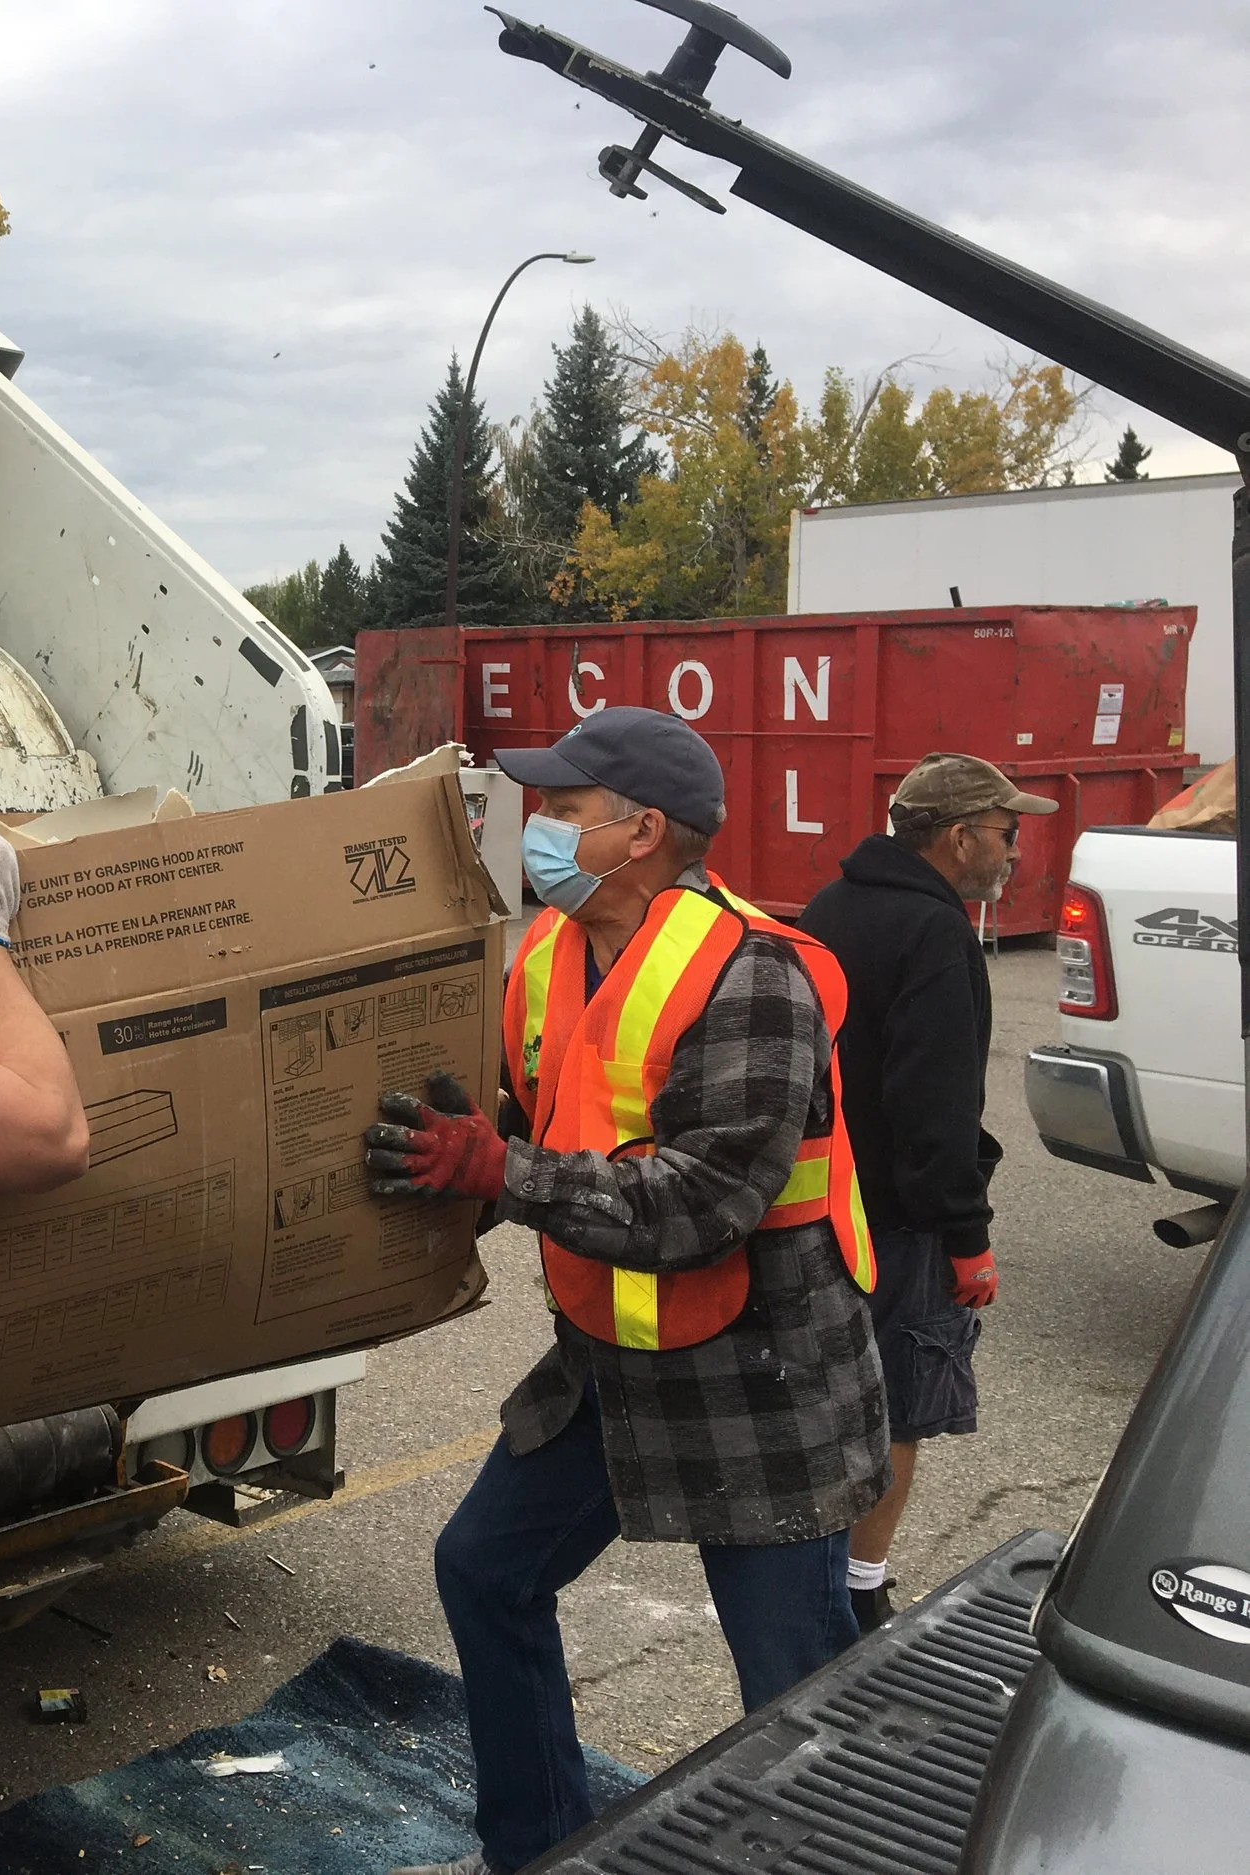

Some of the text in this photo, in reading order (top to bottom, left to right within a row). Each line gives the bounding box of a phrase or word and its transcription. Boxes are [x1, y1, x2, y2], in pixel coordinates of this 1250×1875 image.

[343, 835, 407, 854] TRANSIT TESTED
[40, 874, 70, 890] UNIT
[74, 870, 91, 883] BY
[95, 857, 159, 878] GRASPING
[162, 851, 194, 866] HOOD
[197, 848, 210, 860] AT
[211, 841, 244, 857] FRONT
[27, 890, 73, 908] GRASP
[77, 882, 114, 898] HOOD
[118, 878, 132, 891] AT
[135, 870, 175, 887] FRONT
[178, 862, 223, 879] CENTER.
[55, 931, 74, 944] LA
[76, 922, 120, 940] HOTTE
[122, 917, 139, 930] EN
[142, 914, 158, 927] LA
[160, 903, 212, 923] PRENANT
[214, 899, 236, 912] PAR
[34, 953, 52, 966] NE
[55, 947, 82, 961] PAS
[85, 942, 103, 955] LA
[105, 930, 165, 951] PRENDRE
[166, 924, 191, 939] PAR
[193, 921, 206, 934] LE
[208, 912, 253, 930] CENTRE.
[113, 1025, 133, 1045] 30
[148, 1014, 193, 1029] Range Hood
[149, 1027, 170, 1038] Hotte
[171, 1026, 181, 1034] de
[1180, 1579, 1237, 1613] Range
